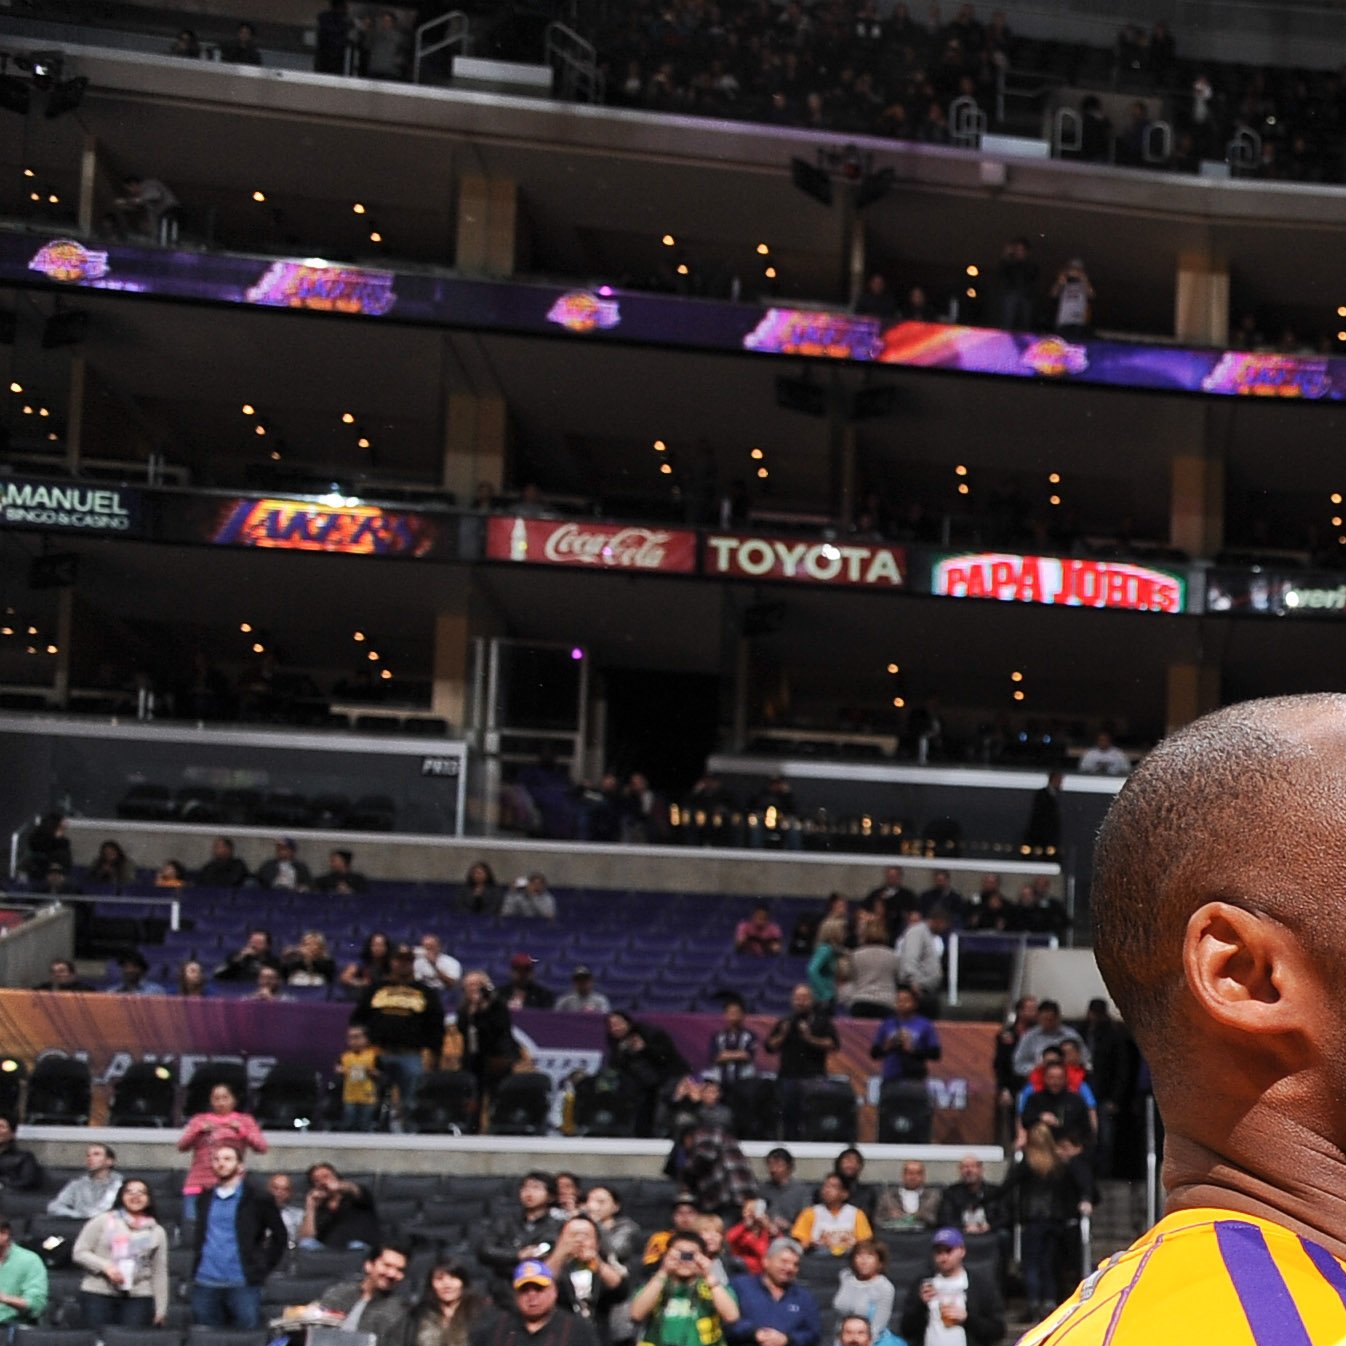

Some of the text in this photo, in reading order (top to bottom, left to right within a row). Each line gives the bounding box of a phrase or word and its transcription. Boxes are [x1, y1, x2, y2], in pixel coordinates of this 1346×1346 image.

[6, 482, 129, 515] MANUEL
[6, 508, 57, 525] BINGO
[71, 513, 129, 530] CASINO
[544, 523, 672, 568] Coca-Cola
[707, 537, 904, 585] TOYOTA
[946, 555, 1042, 602] PAPA
